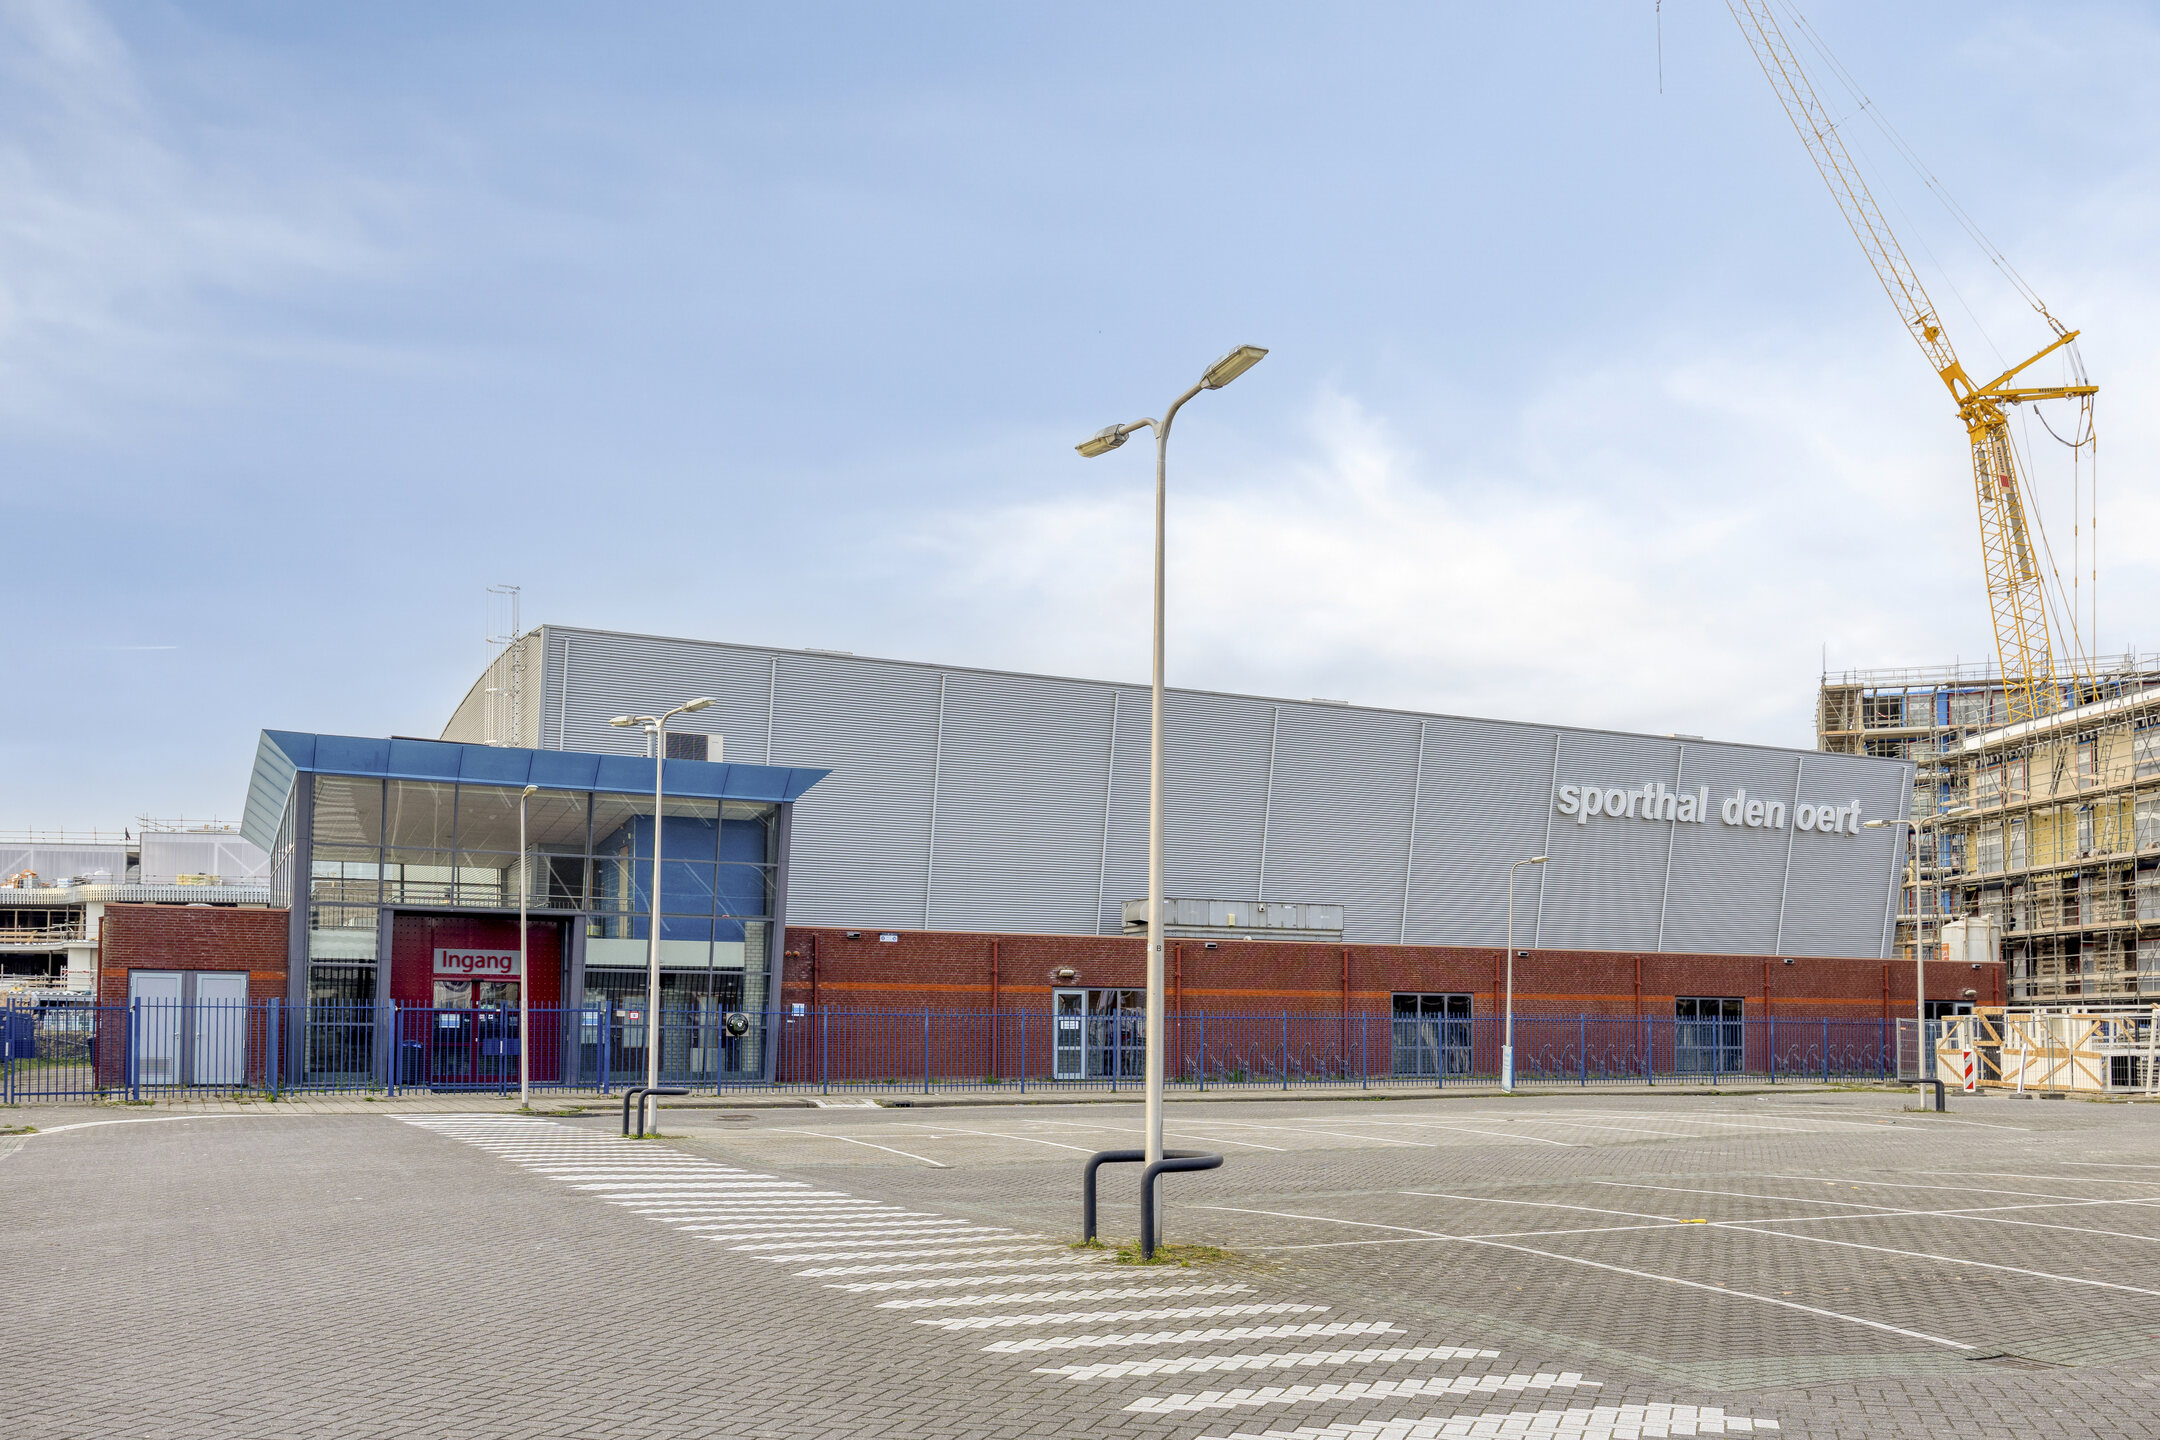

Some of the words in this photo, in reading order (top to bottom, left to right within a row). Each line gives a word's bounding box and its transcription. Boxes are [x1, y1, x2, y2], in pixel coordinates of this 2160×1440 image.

[1557, 782, 1709, 825] sporthal
[1722, 788, 1786, 829] den
[1795, 799, 1862, 835] oert
[442, 950, 512, 973] Ingang
